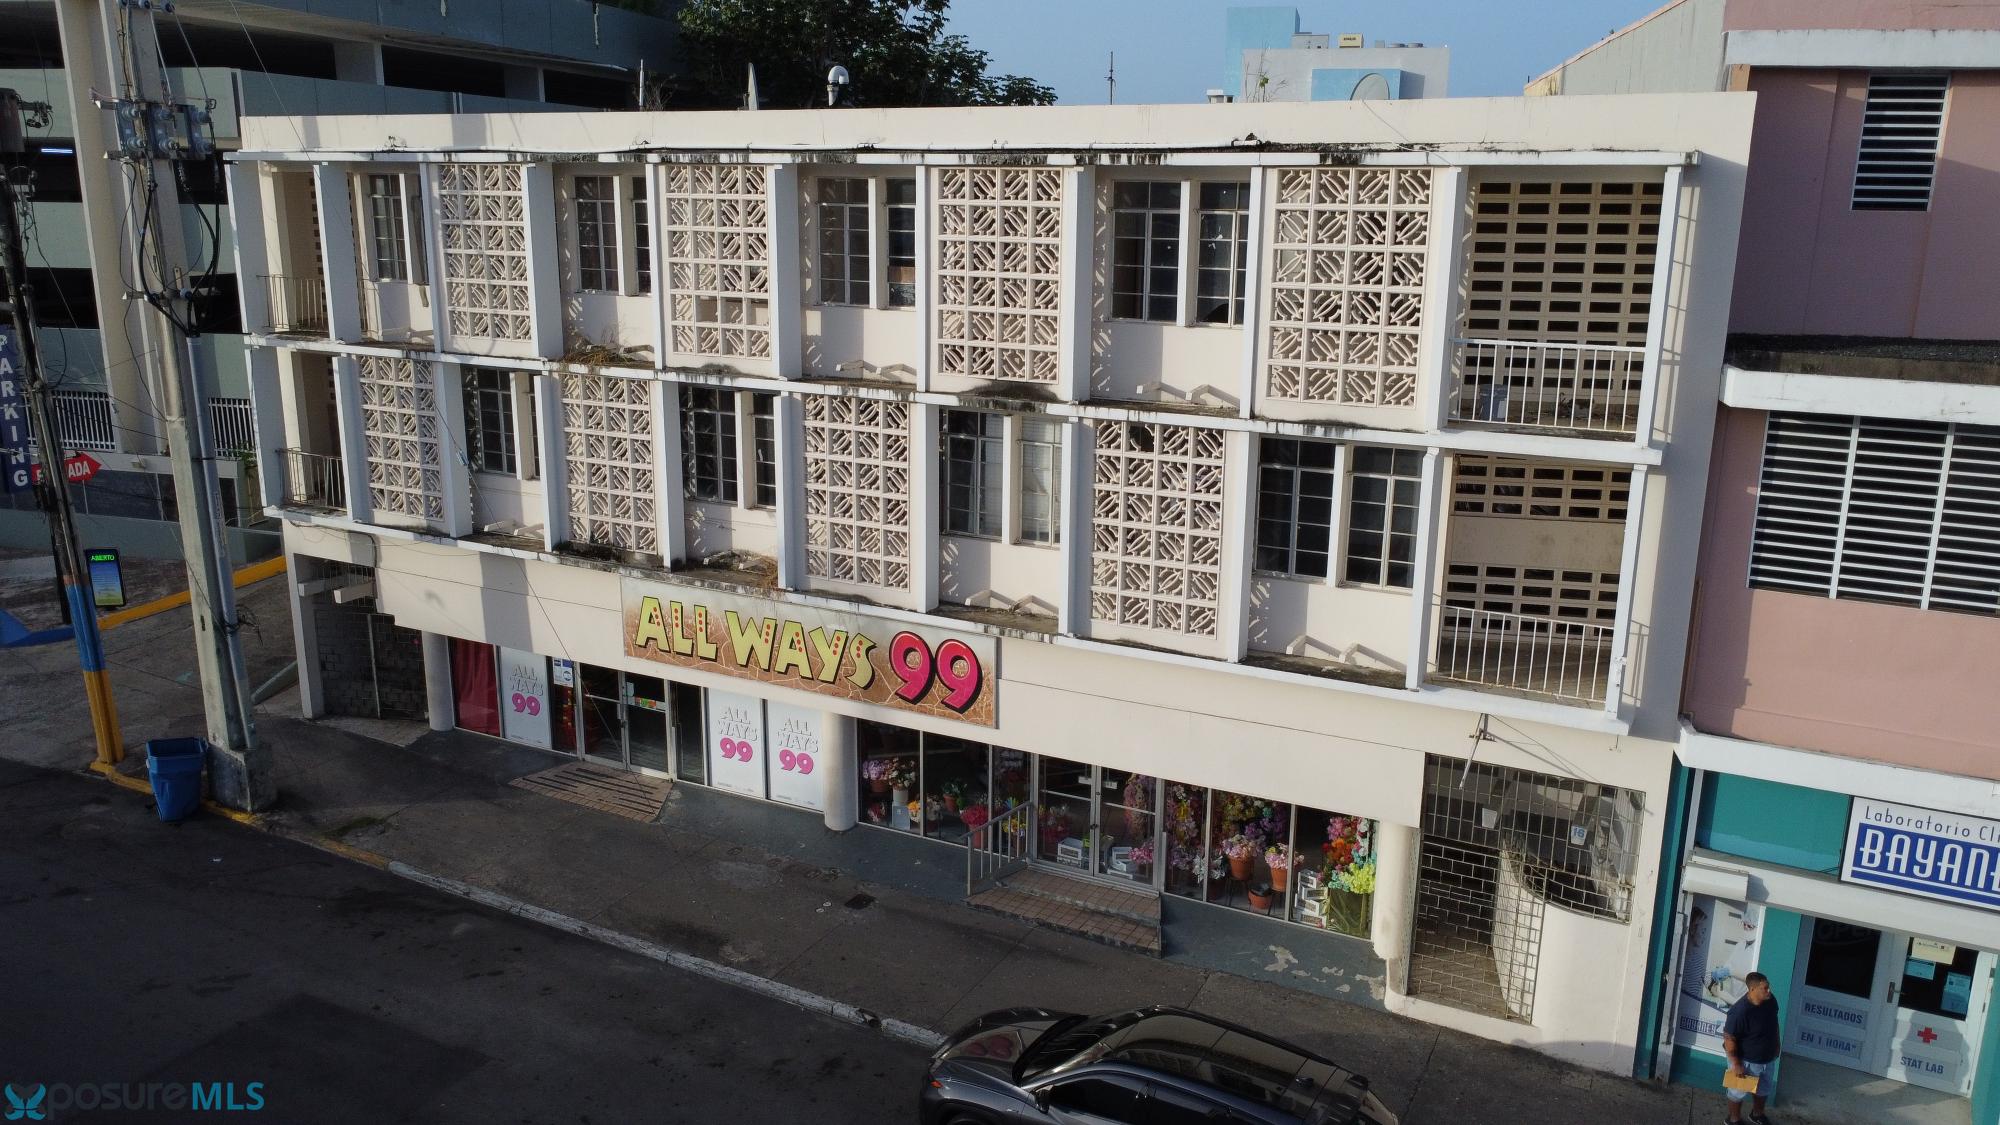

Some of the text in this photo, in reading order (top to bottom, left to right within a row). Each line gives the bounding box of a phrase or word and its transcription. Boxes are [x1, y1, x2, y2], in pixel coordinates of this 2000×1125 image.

[0, 334, 28, 487] PARKING
[634, 596, 984, 714] ALL WAYS 99
[512, 664, 537, 680] ALL
[511, 692, 541, 717] 99
[720, 705, 751, 725] ALL
[782, 718, 812, 737] ALL
[719, 737, 754, 763] 99
[779, 749, 814, 775] 99
[1865, 805, 1971, 837] Laboratorio
[1804, 1002, 1863, 1024] RESULTADOS
[1801, 1032, 1814, 1042] EN
[1900, 1056, 1944, 1074] STAT LAB
